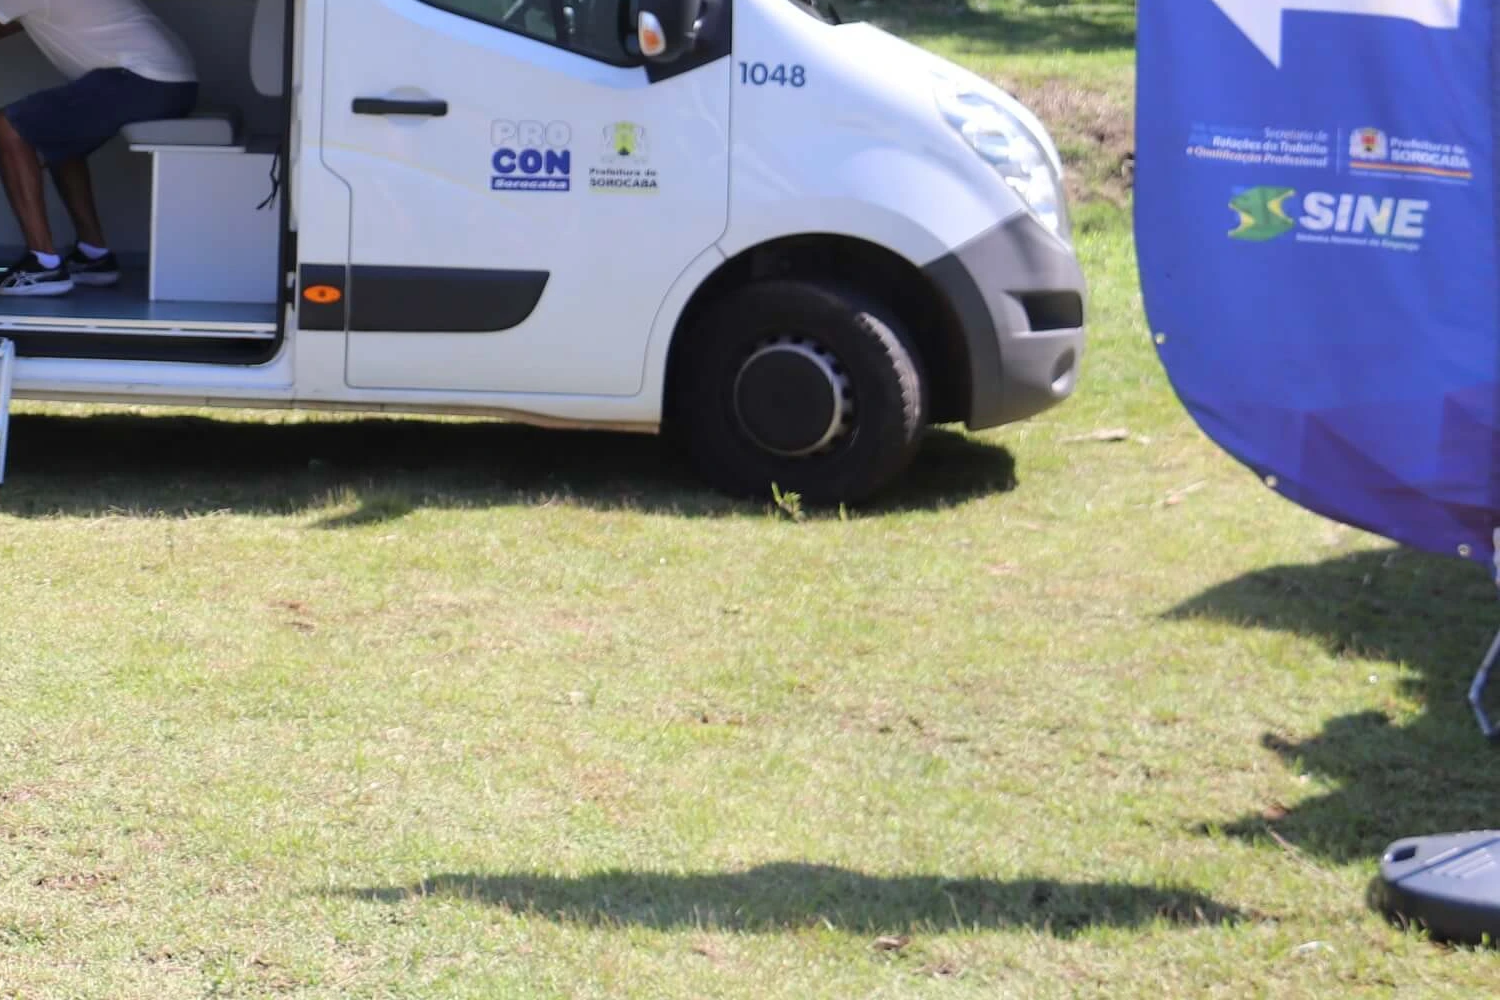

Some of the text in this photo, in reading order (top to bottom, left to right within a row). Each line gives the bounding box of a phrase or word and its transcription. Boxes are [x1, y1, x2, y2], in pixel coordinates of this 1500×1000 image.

[739, 61, 806, 88] 1048
[490, 119, 572, 147] PRO
[492, 148, 571, 175] CON
[1391, 149, 1472, 169] SOROCABA
[494, 178, 567, 190] Sorocaba
[590, 177, 658, 189] SOROCABA
[1298, 190, 1430, 239] SINE
